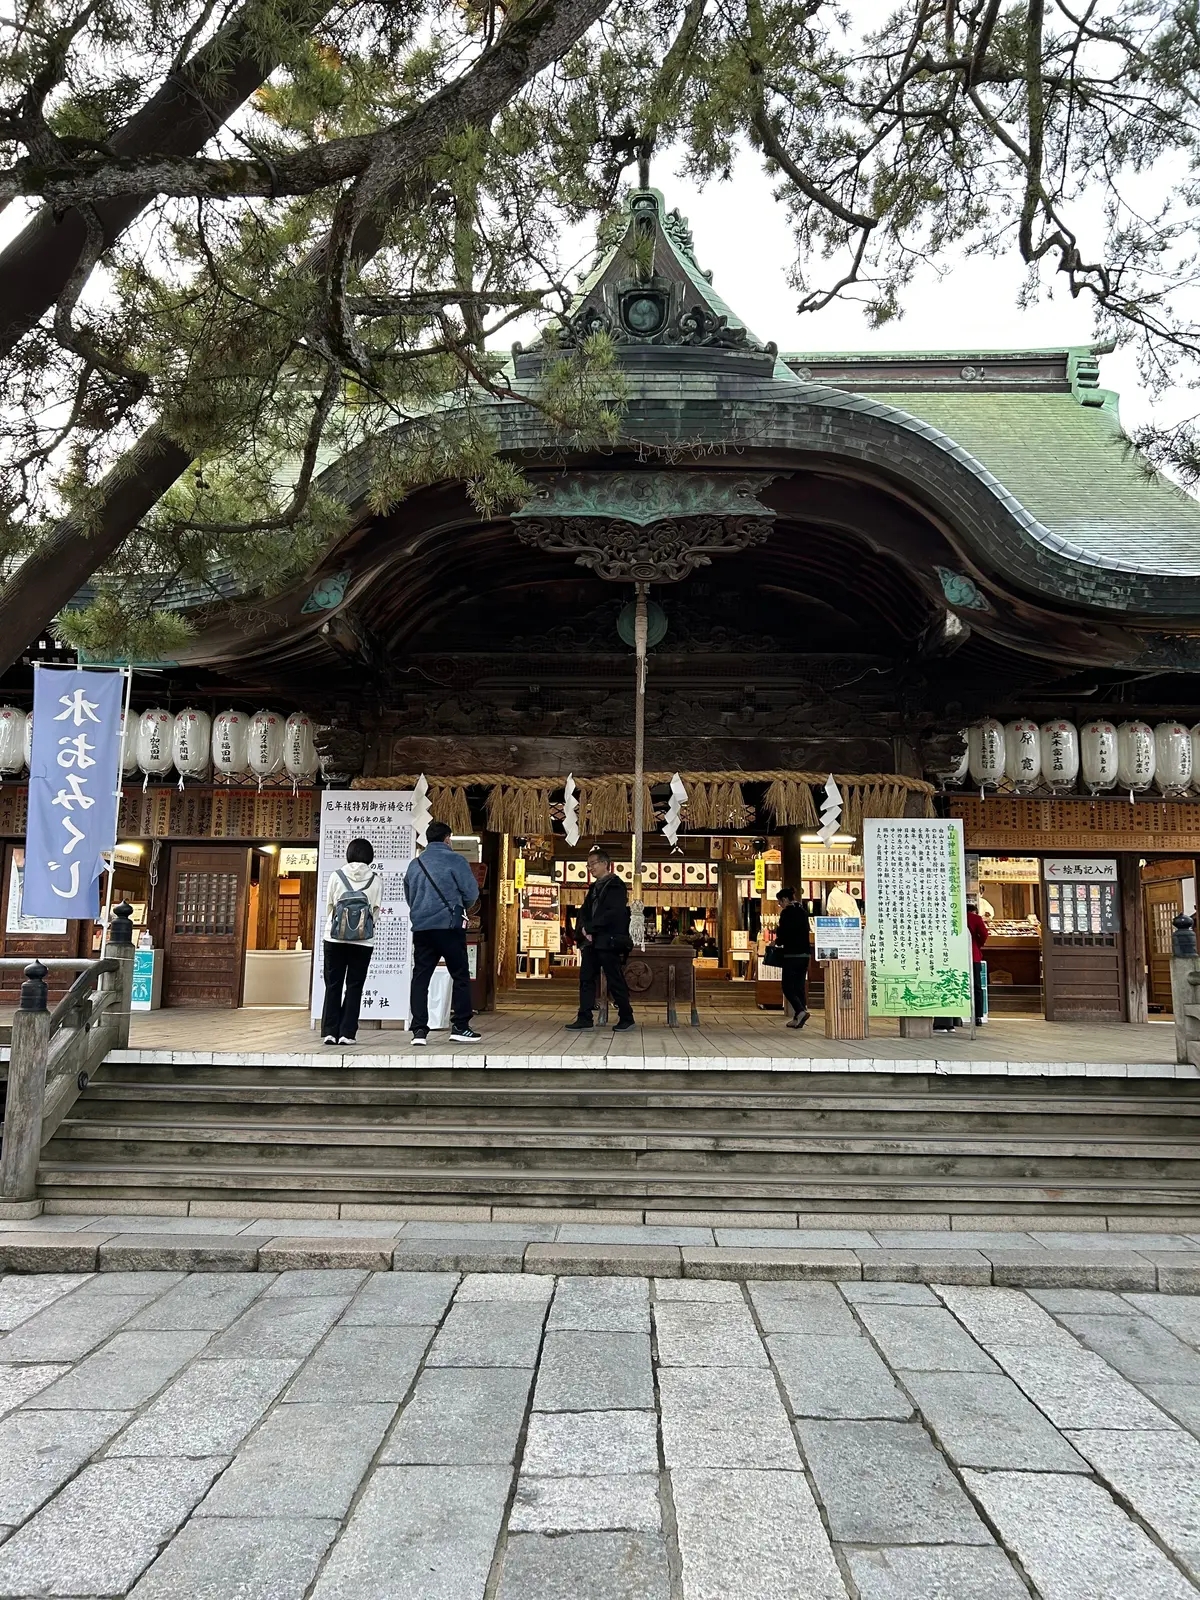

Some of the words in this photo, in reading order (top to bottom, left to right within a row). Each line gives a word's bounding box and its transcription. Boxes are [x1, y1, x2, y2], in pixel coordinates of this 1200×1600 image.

[324, 800, 414, 812] 厄年祓特別御祈祷受付
[346, 815, 393, 823] 令和6年の厄年
[1062, 864, 1114, 875] 絵馬記入所
[947, 823, 959, 937] 白山神社「崇敬会」のご案内
[869, 933, 878, 1007] 白山神社崇敬会事務局
